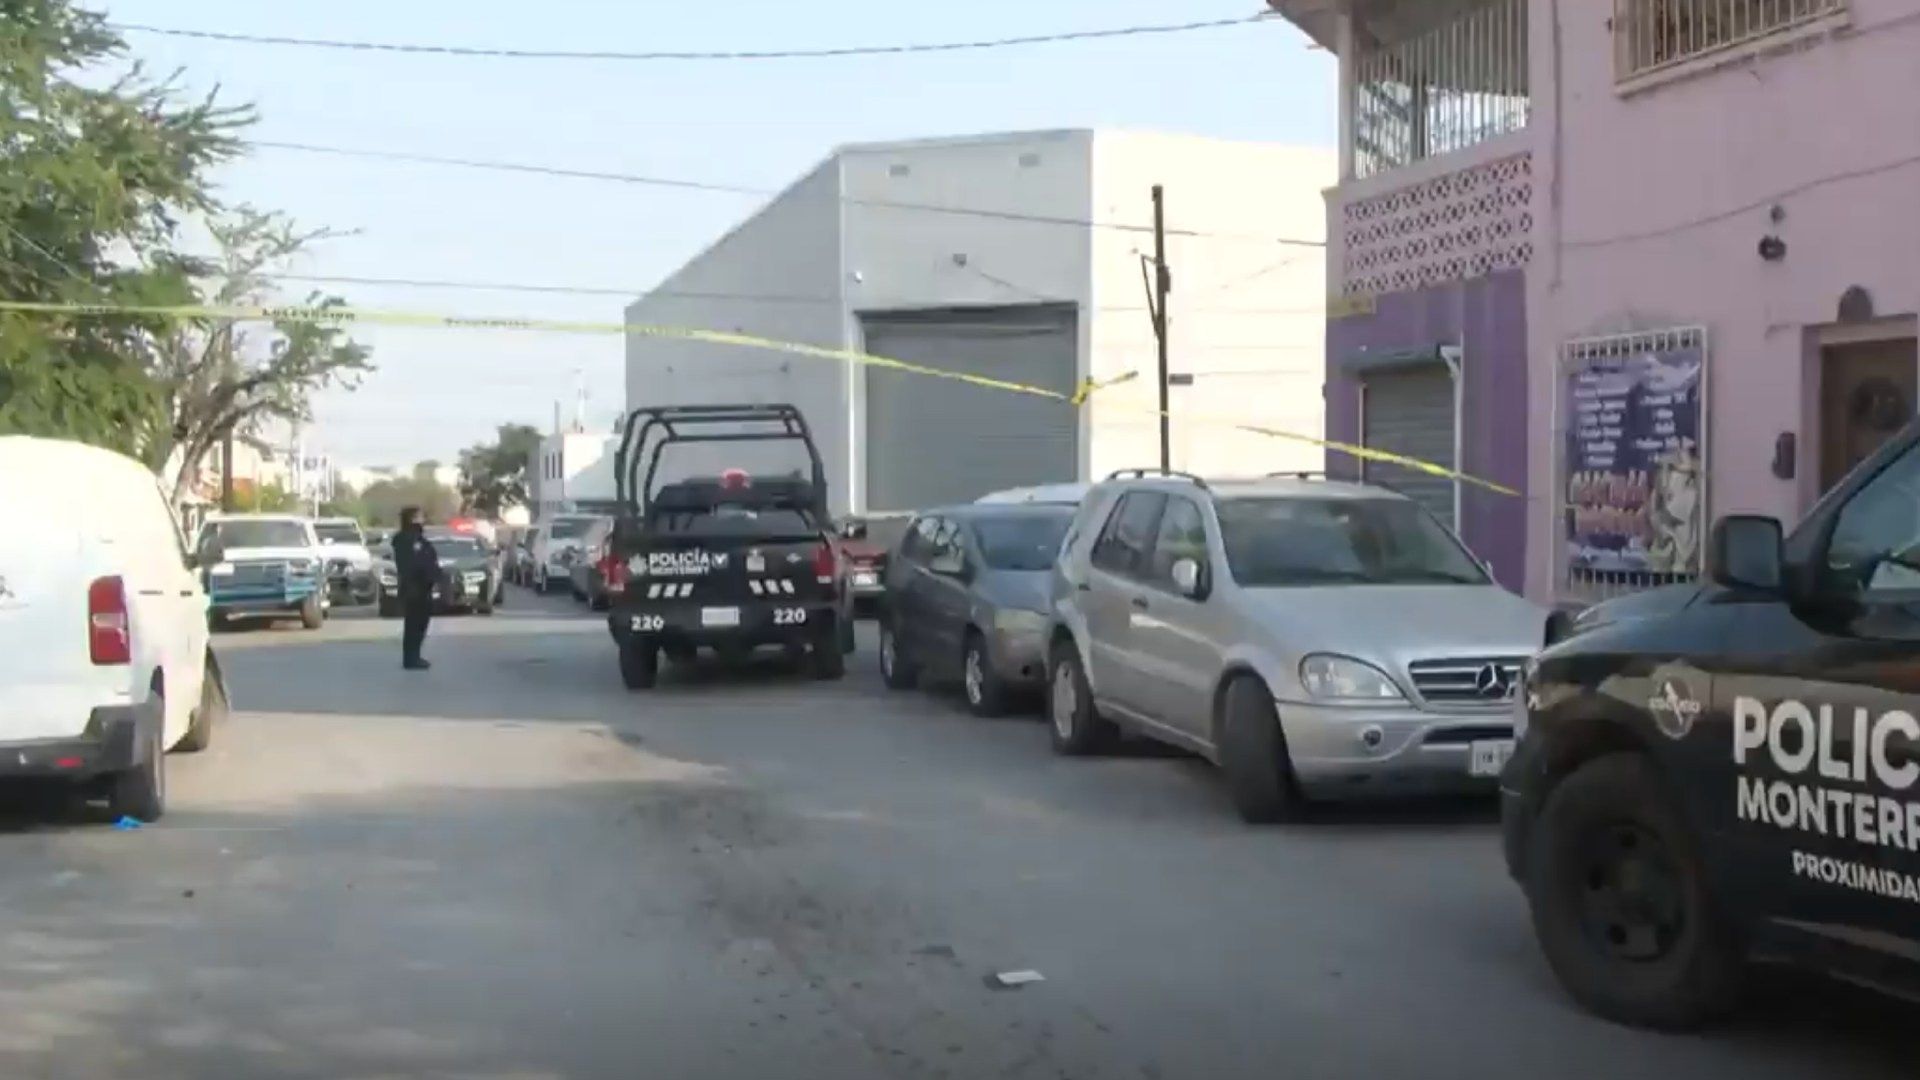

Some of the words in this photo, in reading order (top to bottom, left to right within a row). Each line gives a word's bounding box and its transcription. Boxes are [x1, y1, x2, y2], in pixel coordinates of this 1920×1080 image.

[649, 547, 709, 566] POLICÍA
[631, 615, 665, 631] 220
[773, 607, 807, 624] 220
[1733, 695, 1920, 789] POLIC
[1792, 850, 1920, 903] PROXIMIDA
